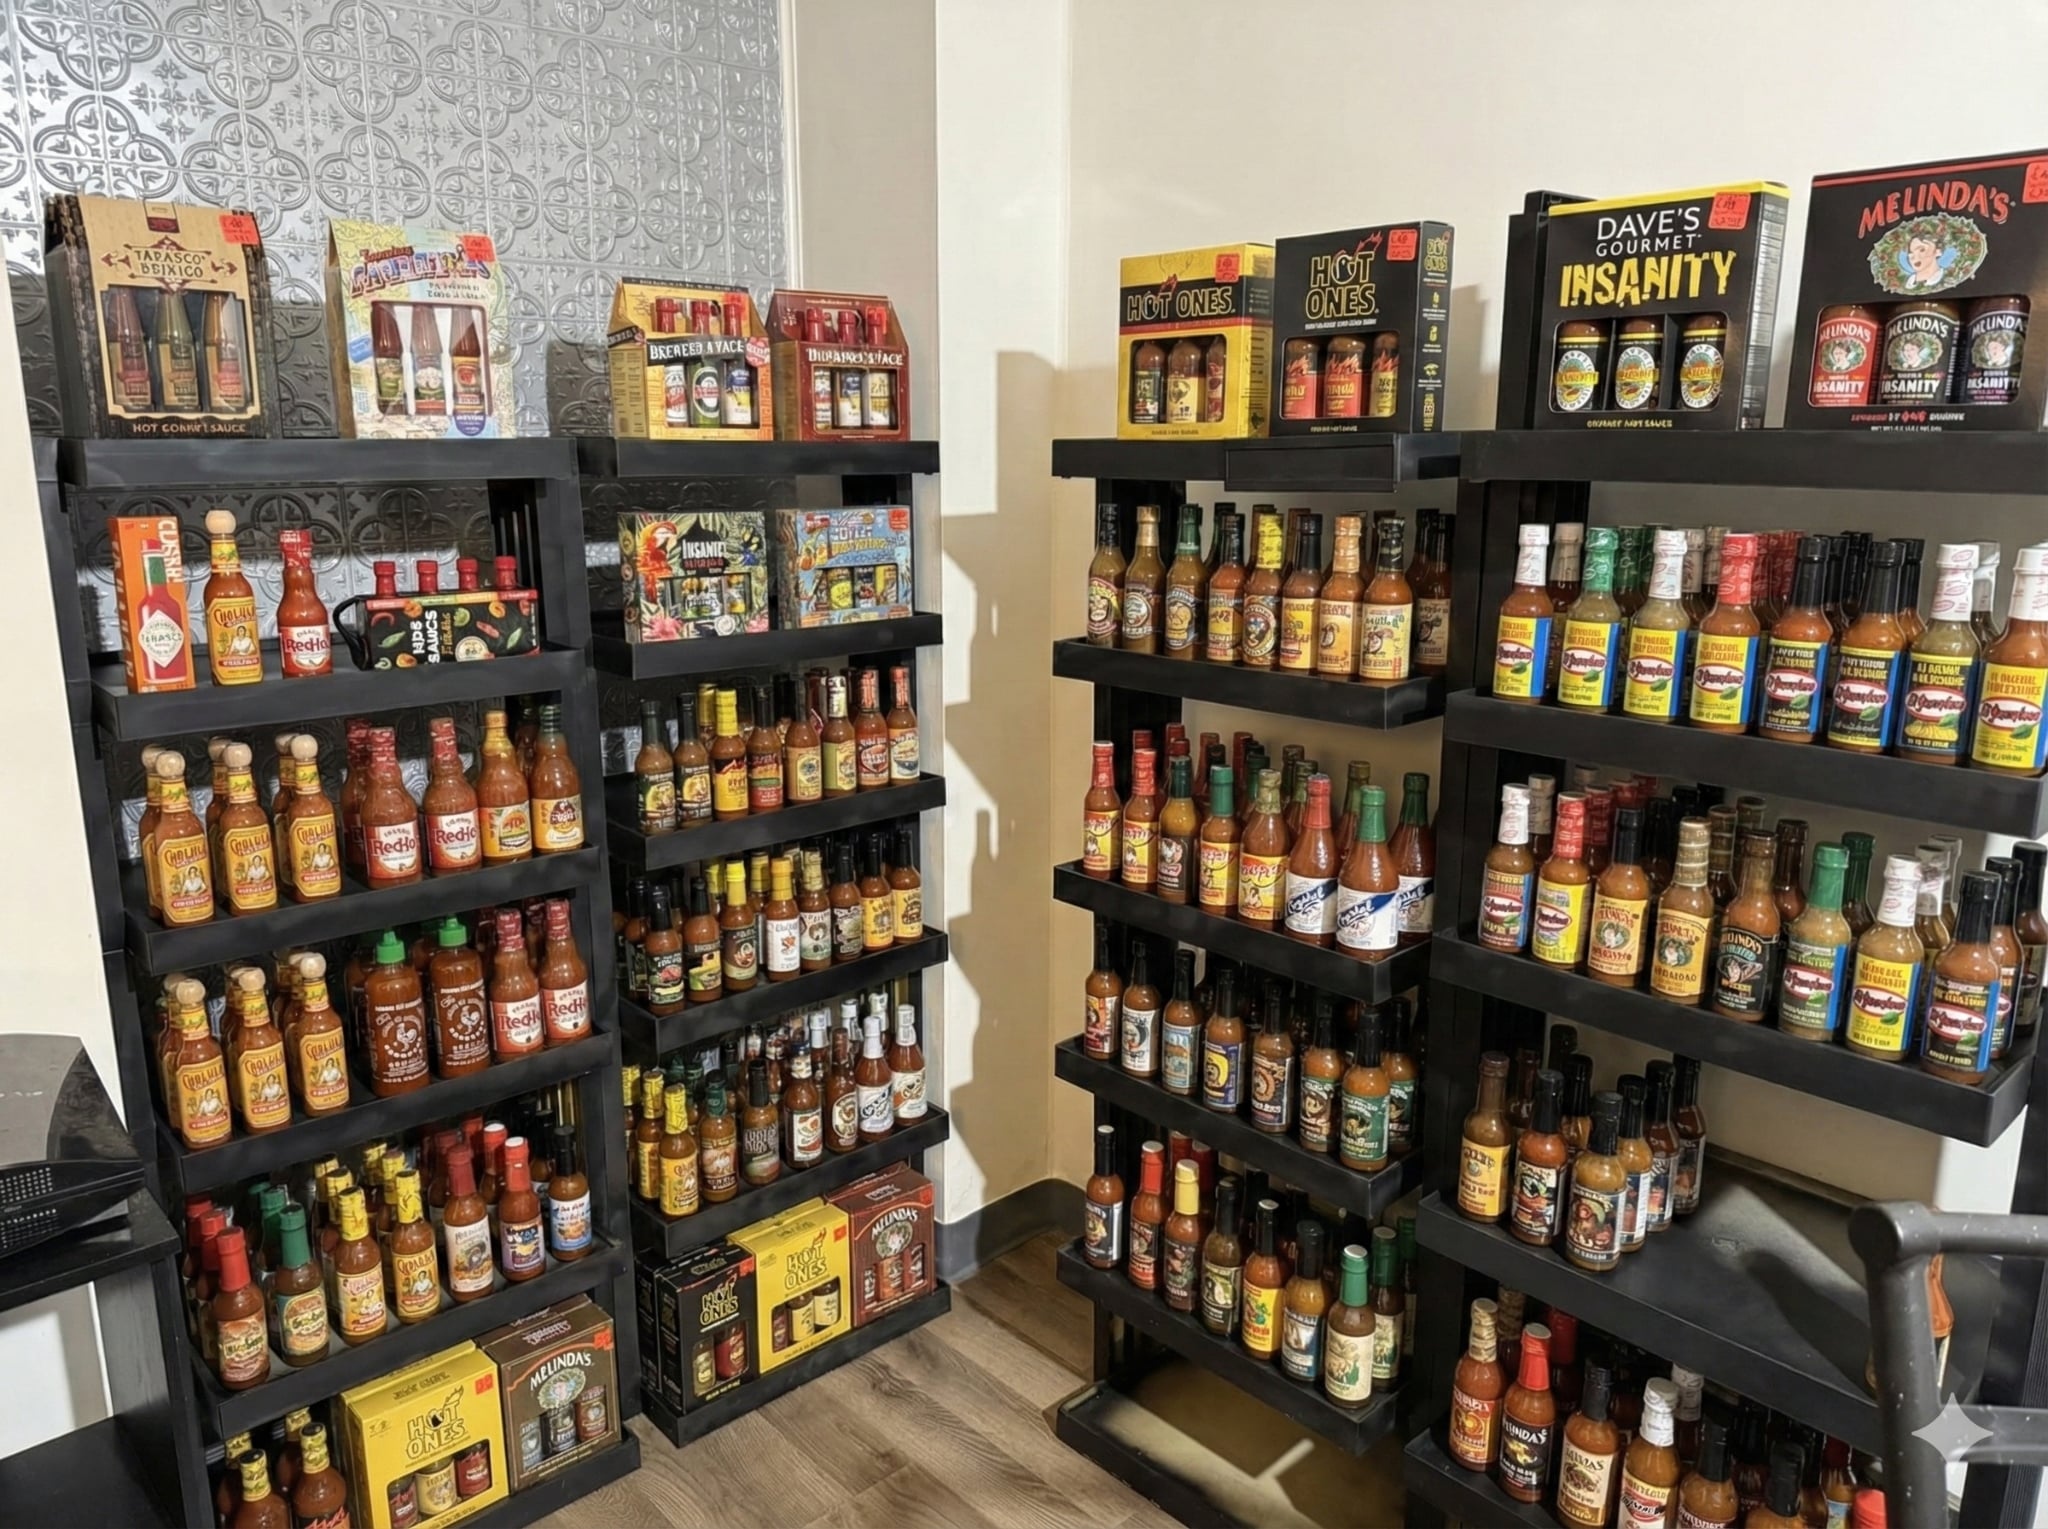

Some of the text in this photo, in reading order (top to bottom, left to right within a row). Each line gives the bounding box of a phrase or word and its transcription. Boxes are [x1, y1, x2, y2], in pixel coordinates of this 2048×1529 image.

[1597, 206, 1701, 241] DAVE'S
[1857, 181, 2010, 239] MELINDA'S
[1596, 234, 1701, 257] GOURMET
[1310, 250, 1375, 287] HOT
[1559, 250, 1737, 308] INSANITY
[1127, 286, 1232, 321] HOT ONES
[1305, 283, 1375, 320] ONES
[406, 1418, 466, 1459] ONES
